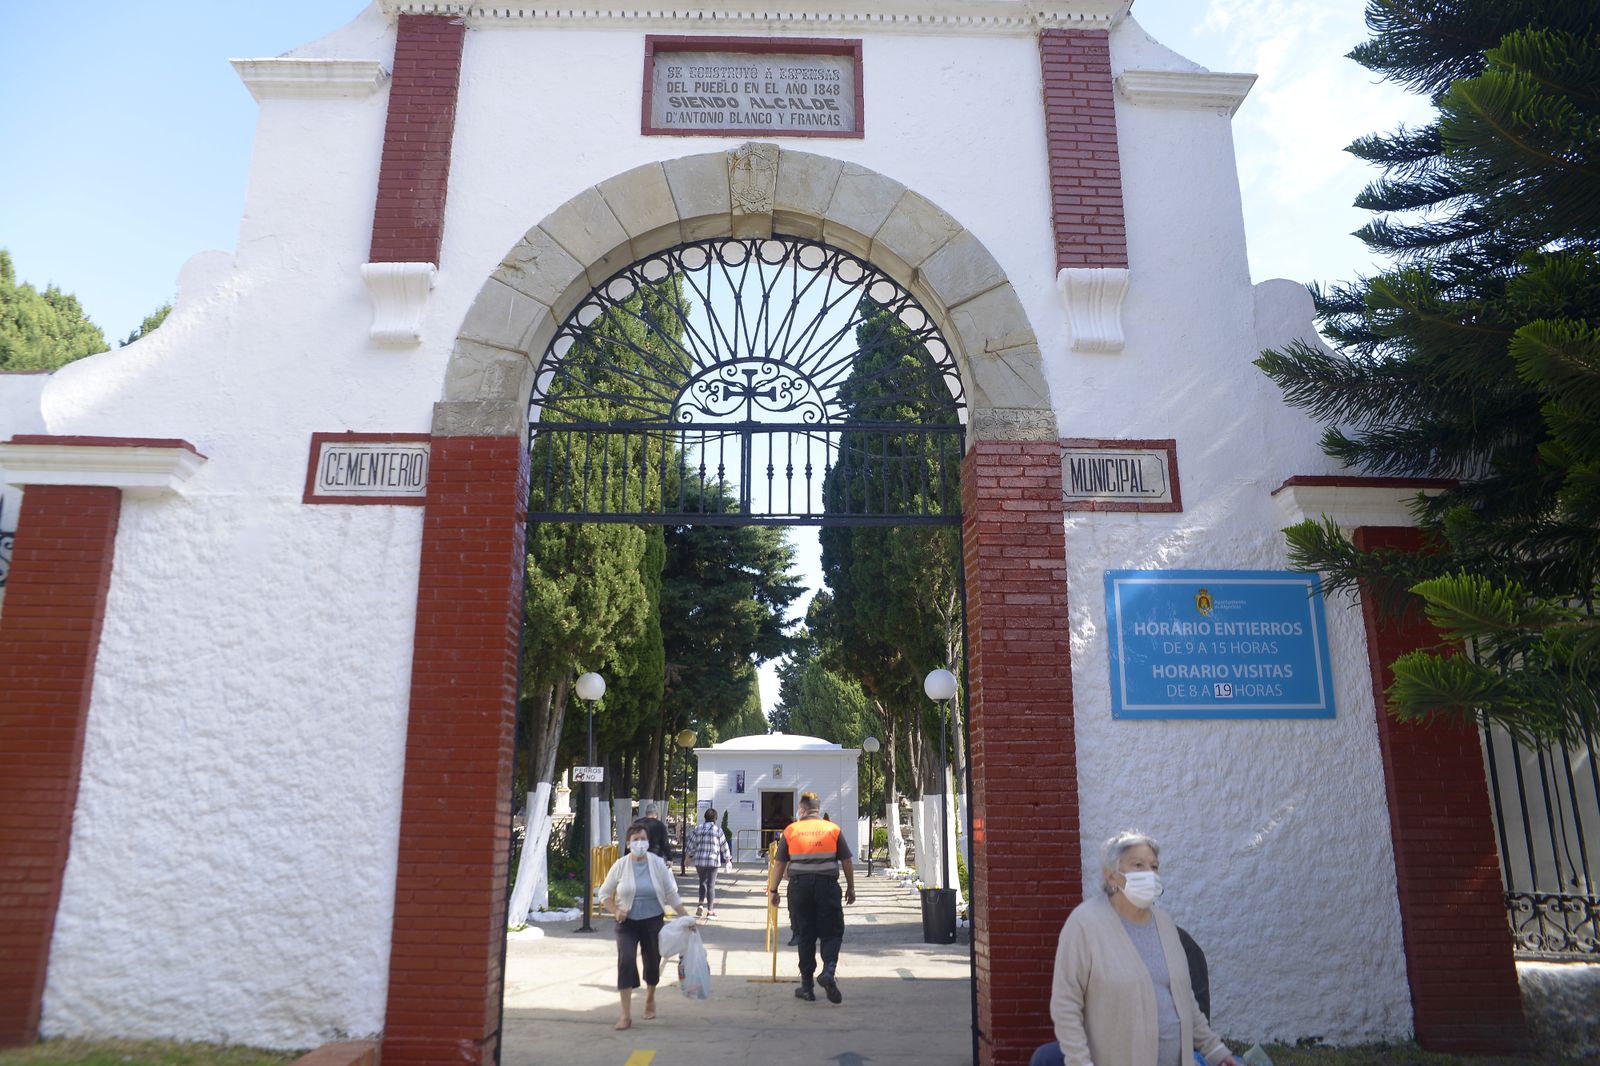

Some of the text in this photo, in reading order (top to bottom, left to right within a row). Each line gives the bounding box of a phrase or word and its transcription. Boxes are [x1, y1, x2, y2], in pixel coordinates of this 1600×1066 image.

[667, 66, 683, 79] SE
[780, 67, 840, 81] ESPENSAS
[666, 81, 688, 93] DEL
[694, 81, 738, 93] PUEBLO
[744, 82, 760, 94] EN
[765, 82, 779, 94] EL
[814, 83, 840, 96] 1848
[668, 96, 840, 111] SIENDO ALCALDE
[729, 111, 773, 124] BLANCO
[778, 112, 785, 125] Y
[325, 452, 424, 487] CEMENTERIO
[1134, 622, 1303, 636] HORARIO ENTIERROS
[1163, 641, 1278, 654] DE 9 A 15 HORAS
[1152, 664, 1293, 678] HORARIO VISITAS
[1167, 683, 1283, 697] DE 8 A 19 HORAS
